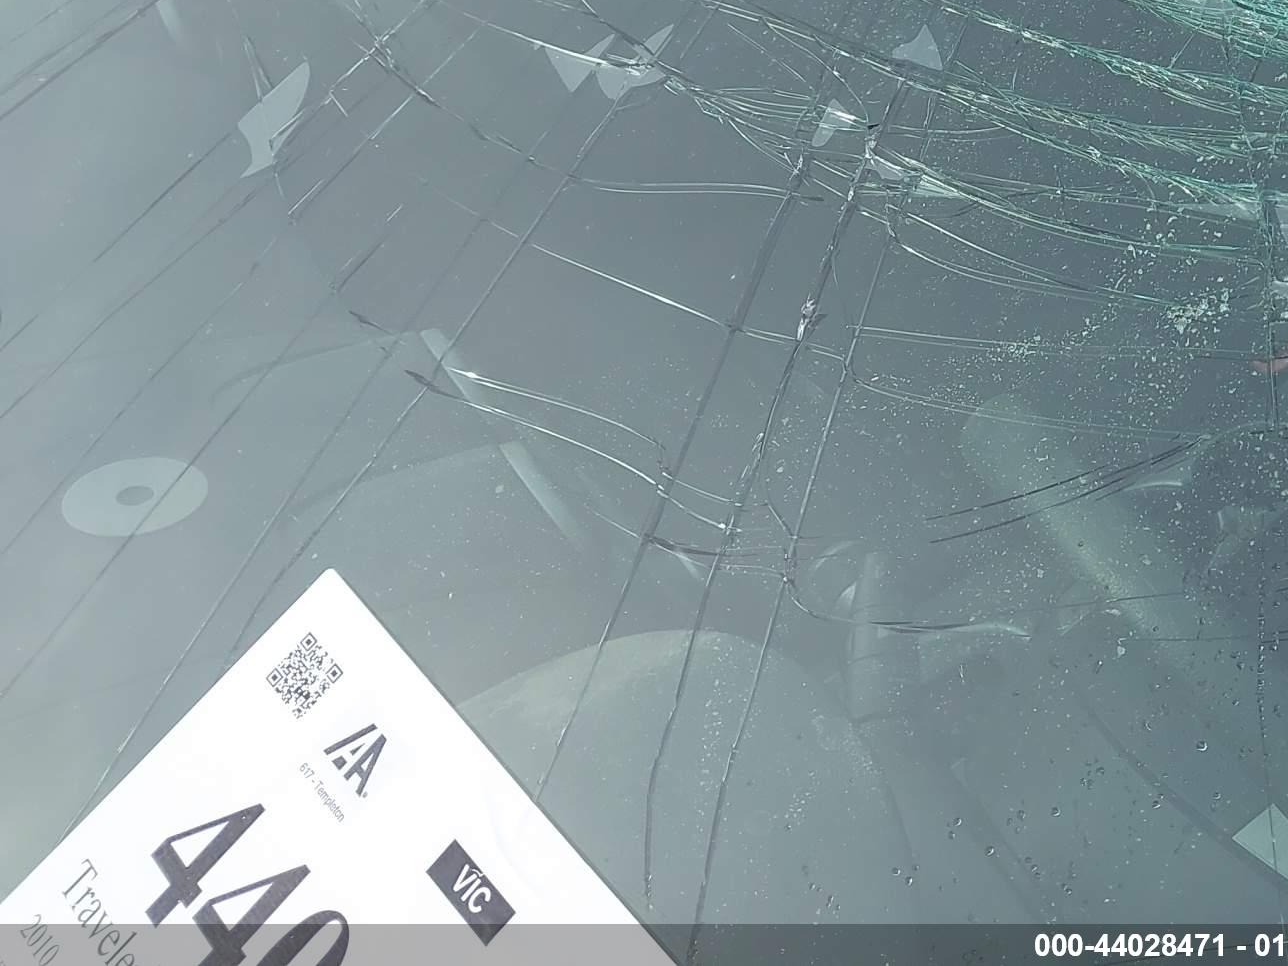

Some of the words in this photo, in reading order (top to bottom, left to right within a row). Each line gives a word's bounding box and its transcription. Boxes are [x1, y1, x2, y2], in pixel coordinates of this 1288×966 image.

[299, 762, 315, 779] 617
[314, 780, 345, 823] Templeton
[452, 863, 492, 914] VIC
[20, 914, 60, 966] 2010
